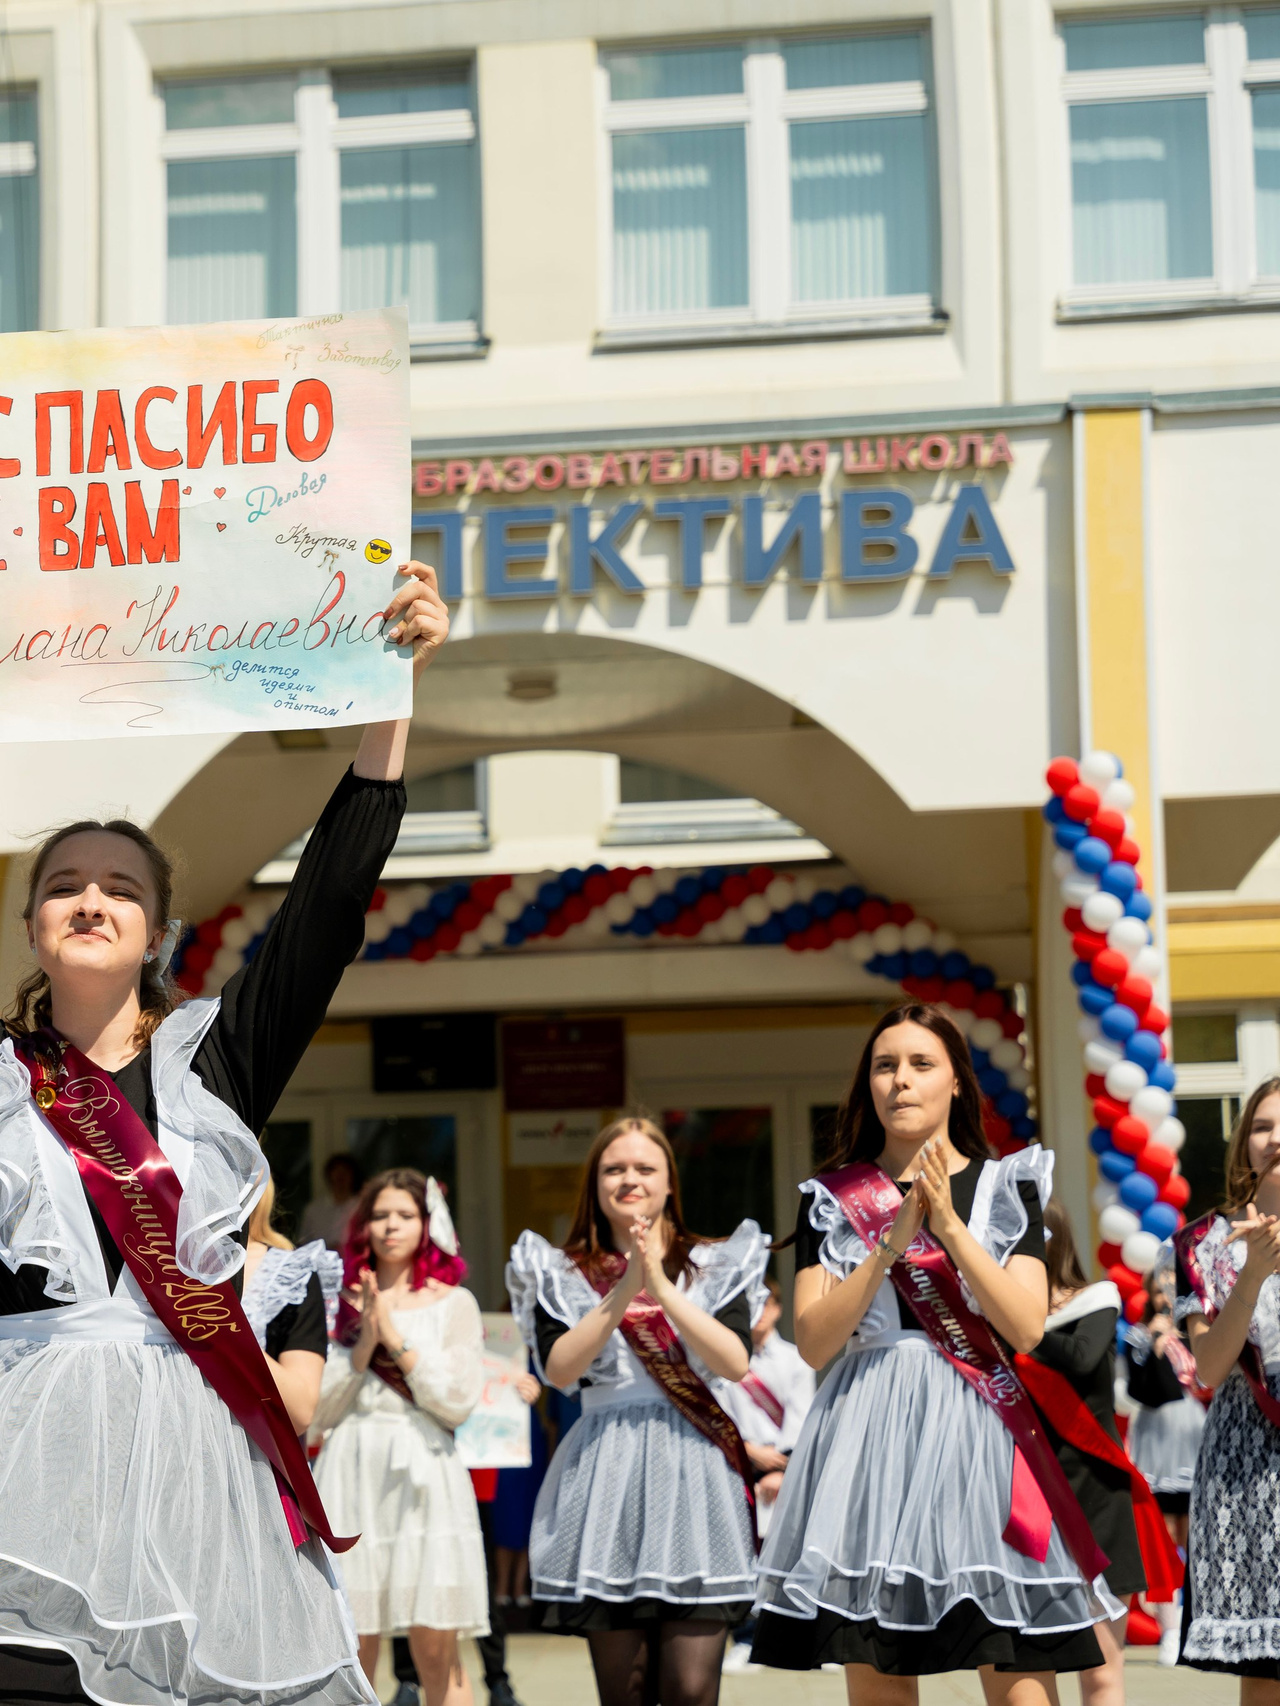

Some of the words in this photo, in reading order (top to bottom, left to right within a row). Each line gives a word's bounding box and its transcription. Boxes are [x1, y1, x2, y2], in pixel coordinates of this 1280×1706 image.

[256, 313, 344, 350] Тактичная
[317, 341, 402, 375] Заботливая
[414, 440, 828, 497] БРАЗОВАТЕЛЬНАЯ
[843, 431, 1015, 475] ШКОЛА
[245, 472, 328, 523] Деловая
[38, 479, 181, 572] ВАМ
[275, 522, 358, 559] Крутая
[122, 570, 400, 656] Николаевна
[225, 659, 301, 682] делится
[259, 678, 317, 694] идеями
[287, 692, 298, 701] и
[56, 1075, 180, 1277] Выпускница
[160, 1277, 242, 1342] 2025
[980, 1363, 1023, 1407] 2025
